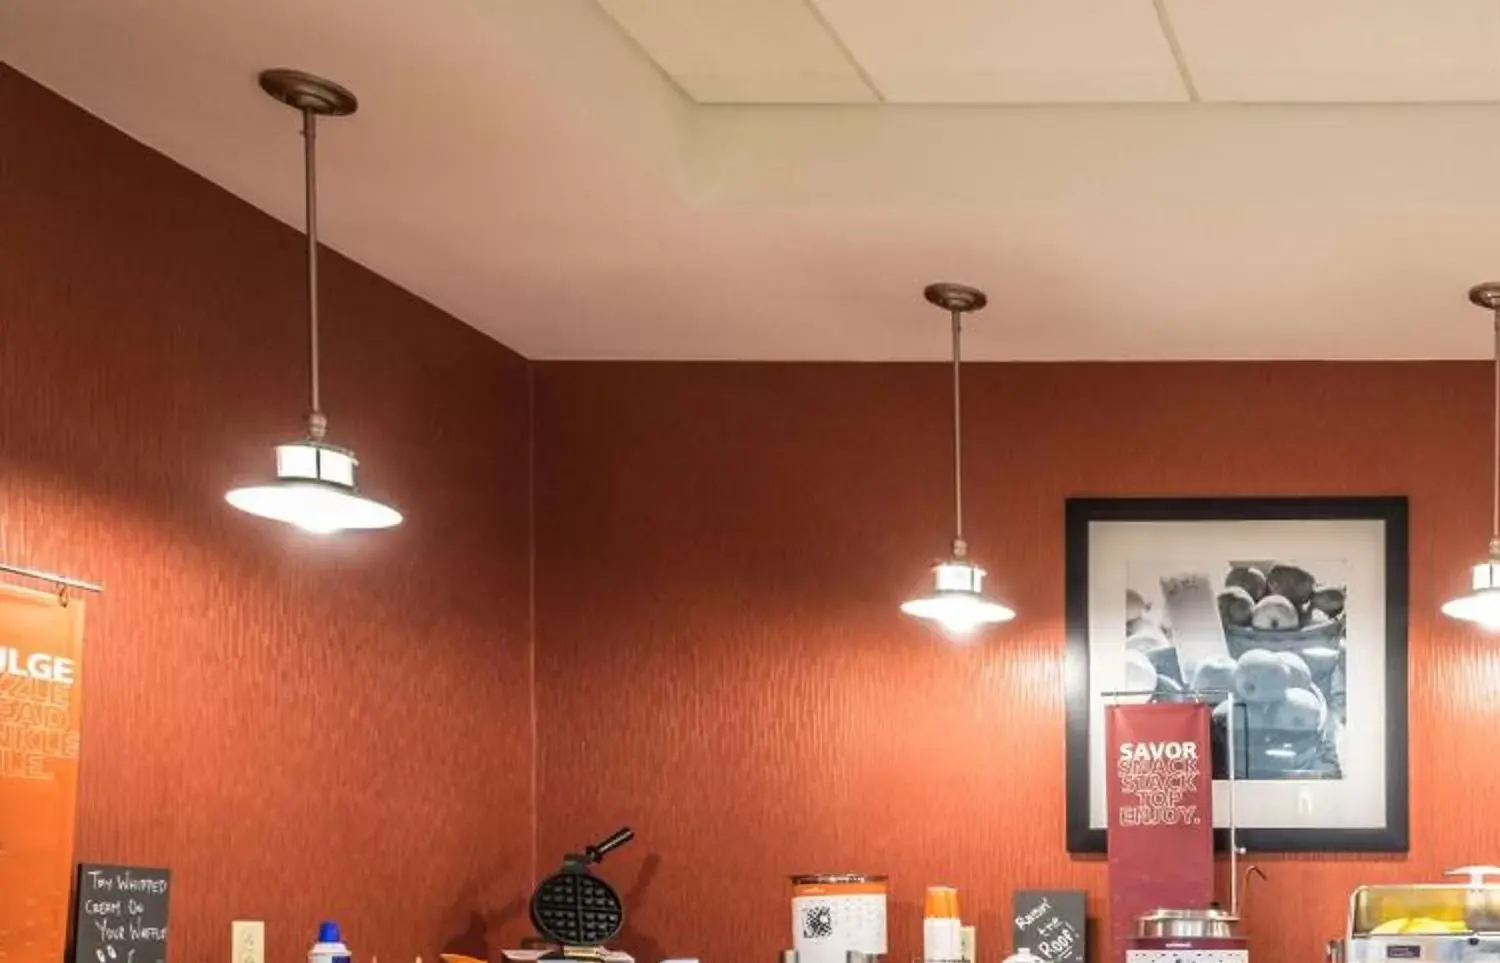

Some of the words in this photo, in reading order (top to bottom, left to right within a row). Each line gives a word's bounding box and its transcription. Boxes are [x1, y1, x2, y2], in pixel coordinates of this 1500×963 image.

[1120, 742, 1197, 761] SAVOR
[1120, 774, 1197, 794] STACK
[1135, 789, 1184, 809] TOP
